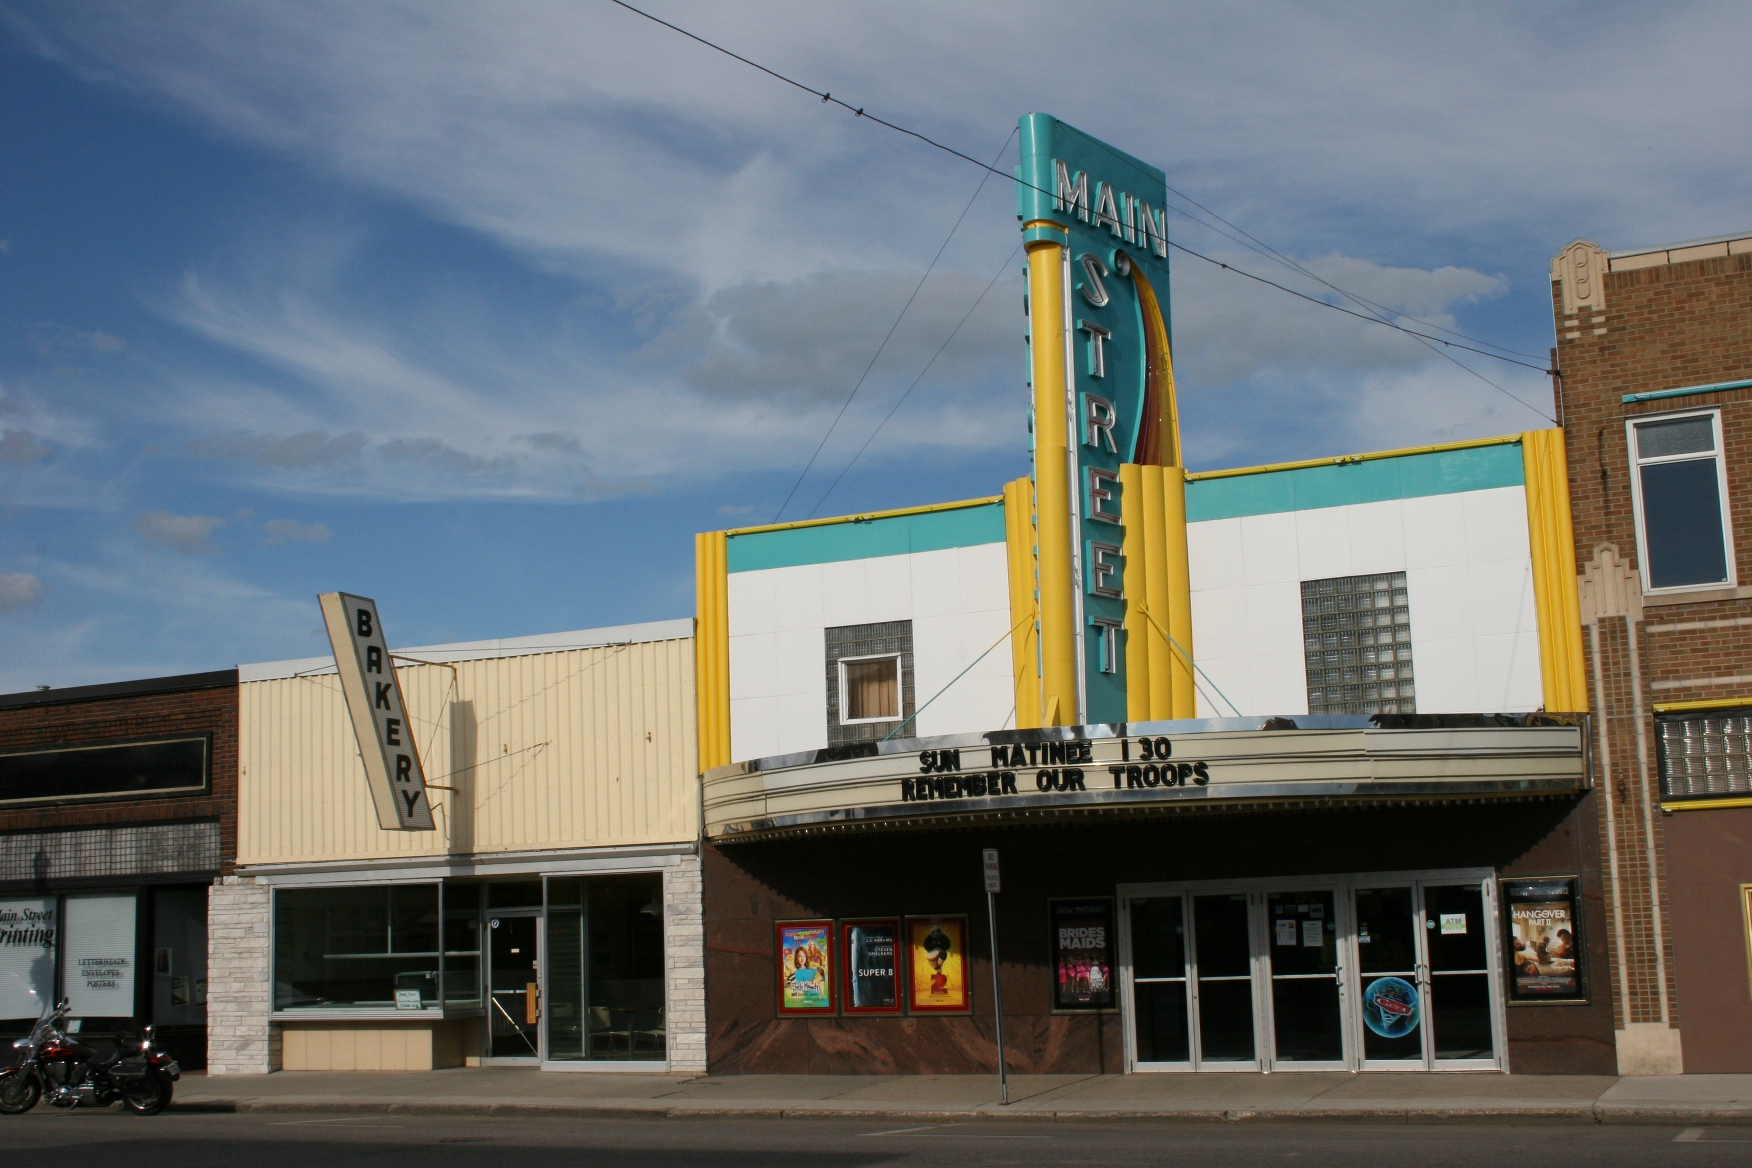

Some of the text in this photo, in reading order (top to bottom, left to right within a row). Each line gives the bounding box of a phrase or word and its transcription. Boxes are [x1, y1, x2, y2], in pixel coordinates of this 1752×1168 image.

[1051, 158, 1167, 259] MAIN
[1076, 253, 1125, 675] STREET
[357, 608, 421, 818] BAKERY
[919, 749, 961, 773] SUN
[991, 739, 1093, 768] MATINEE
[1138, 736, 1172, 761] 30
[901, 761, 1210, 801] REMEMBER OUR TROOPS
[0, 908, 53, 921] ain Street
[1513, 909, 1566, 919] HANGOVER
[1528, 918, 1544, 926] PART
[1059, 926, 1105, 938] BRIDES
[1060, 937, 1106, 949] MAIDS
[78, 958, 126, 966] LETTERHEADS
[858, 968, 894, 977] SUPER 8
[86, 980, 116, 988] POSTERS
[930, 974, 948, 994] 2
